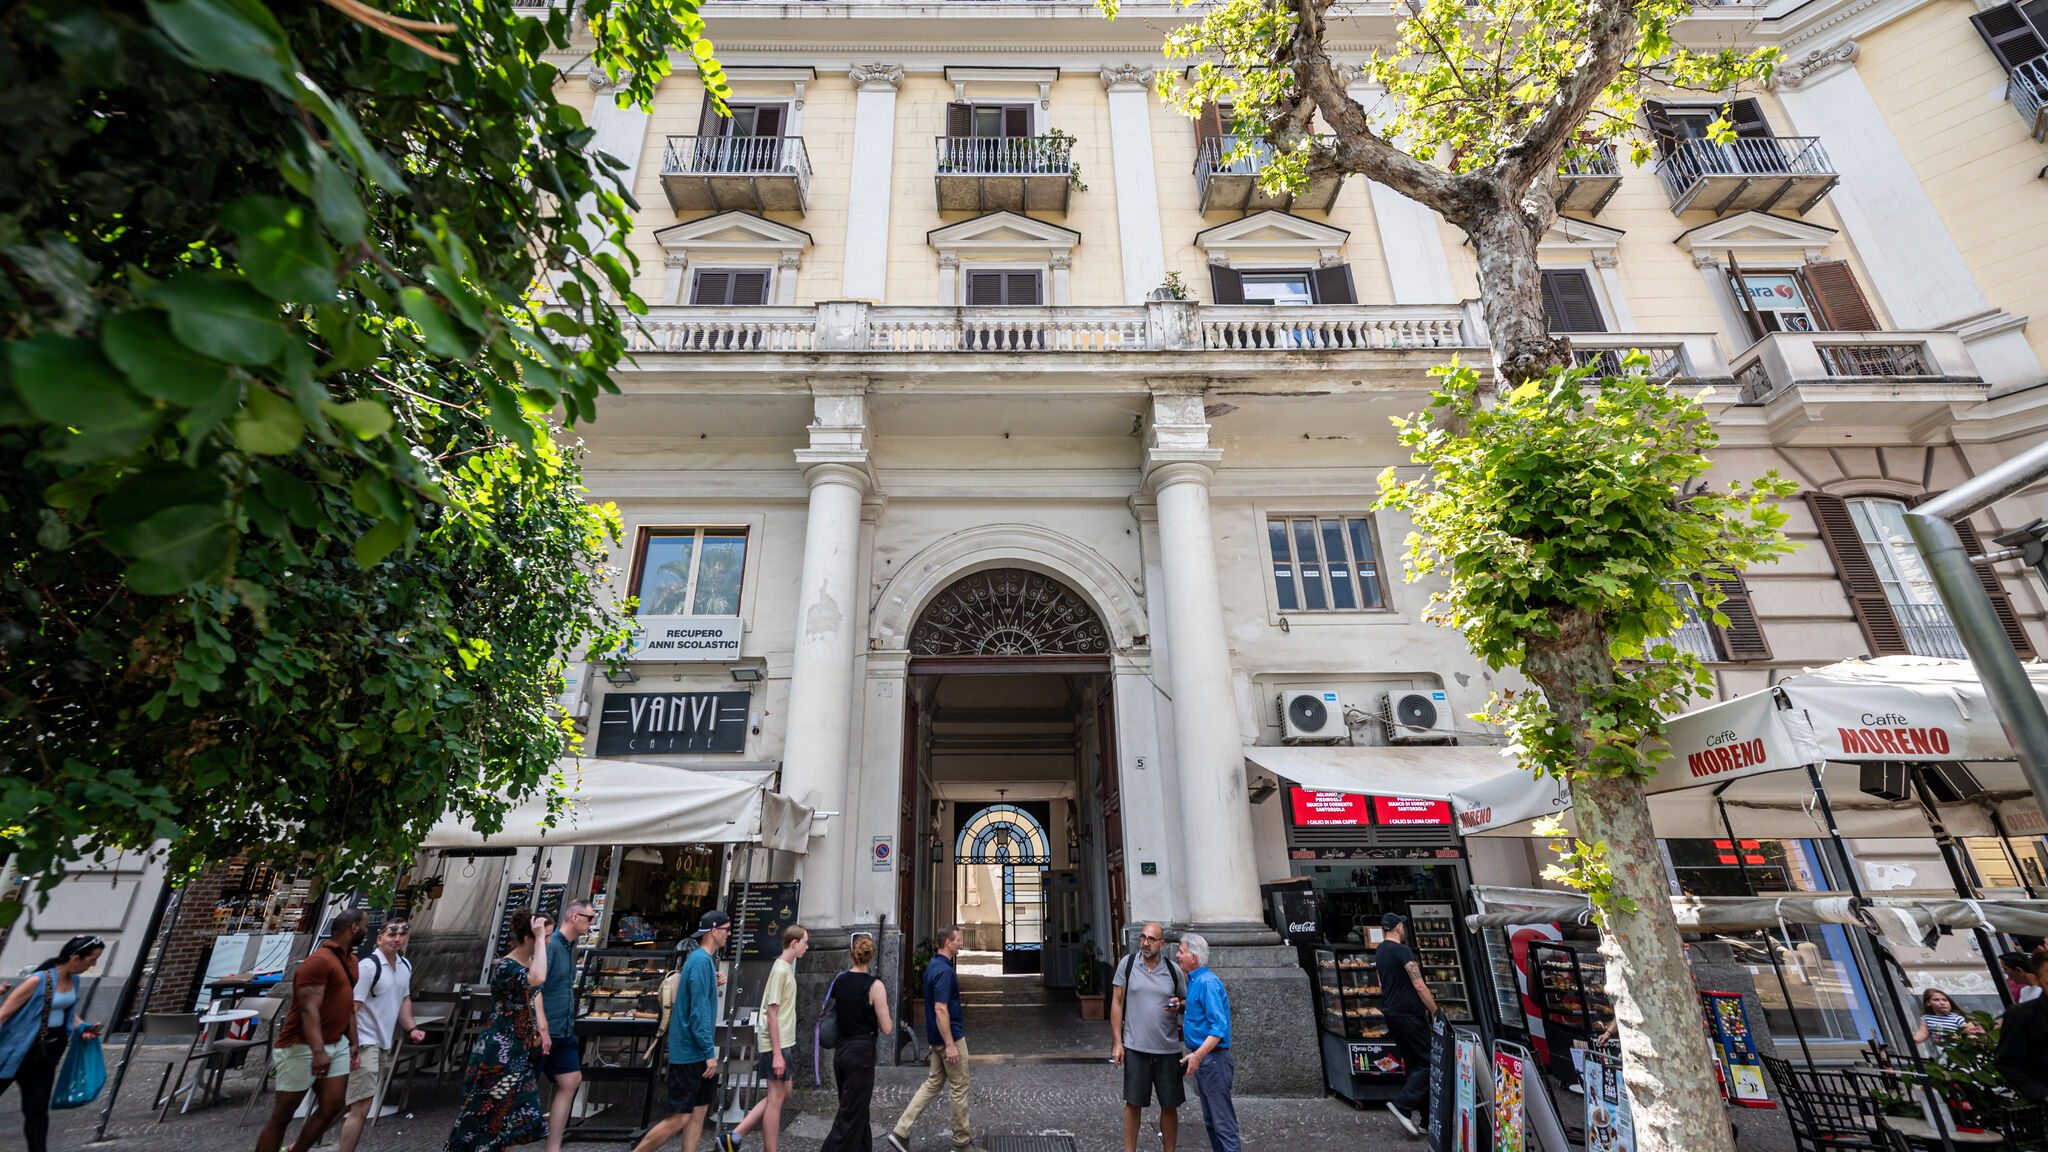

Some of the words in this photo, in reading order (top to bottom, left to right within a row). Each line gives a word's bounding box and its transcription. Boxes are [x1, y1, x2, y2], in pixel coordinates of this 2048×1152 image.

[667, 629, 723, 638] RECUPERO
[648, 641, 675, 649] ANNI
[677, 641, 738, 649] SCOLASTICI
[630, 696, 718, 734] VANVI
[1861, 713, 1908, 726] Caffè
[1706, 730, 1738, 747] Caffè
[1837, 727, 1951, 755] MORENO
[1137, 759, 1144, 767] 5
[1688, 737, 1767, 778] MORENO
